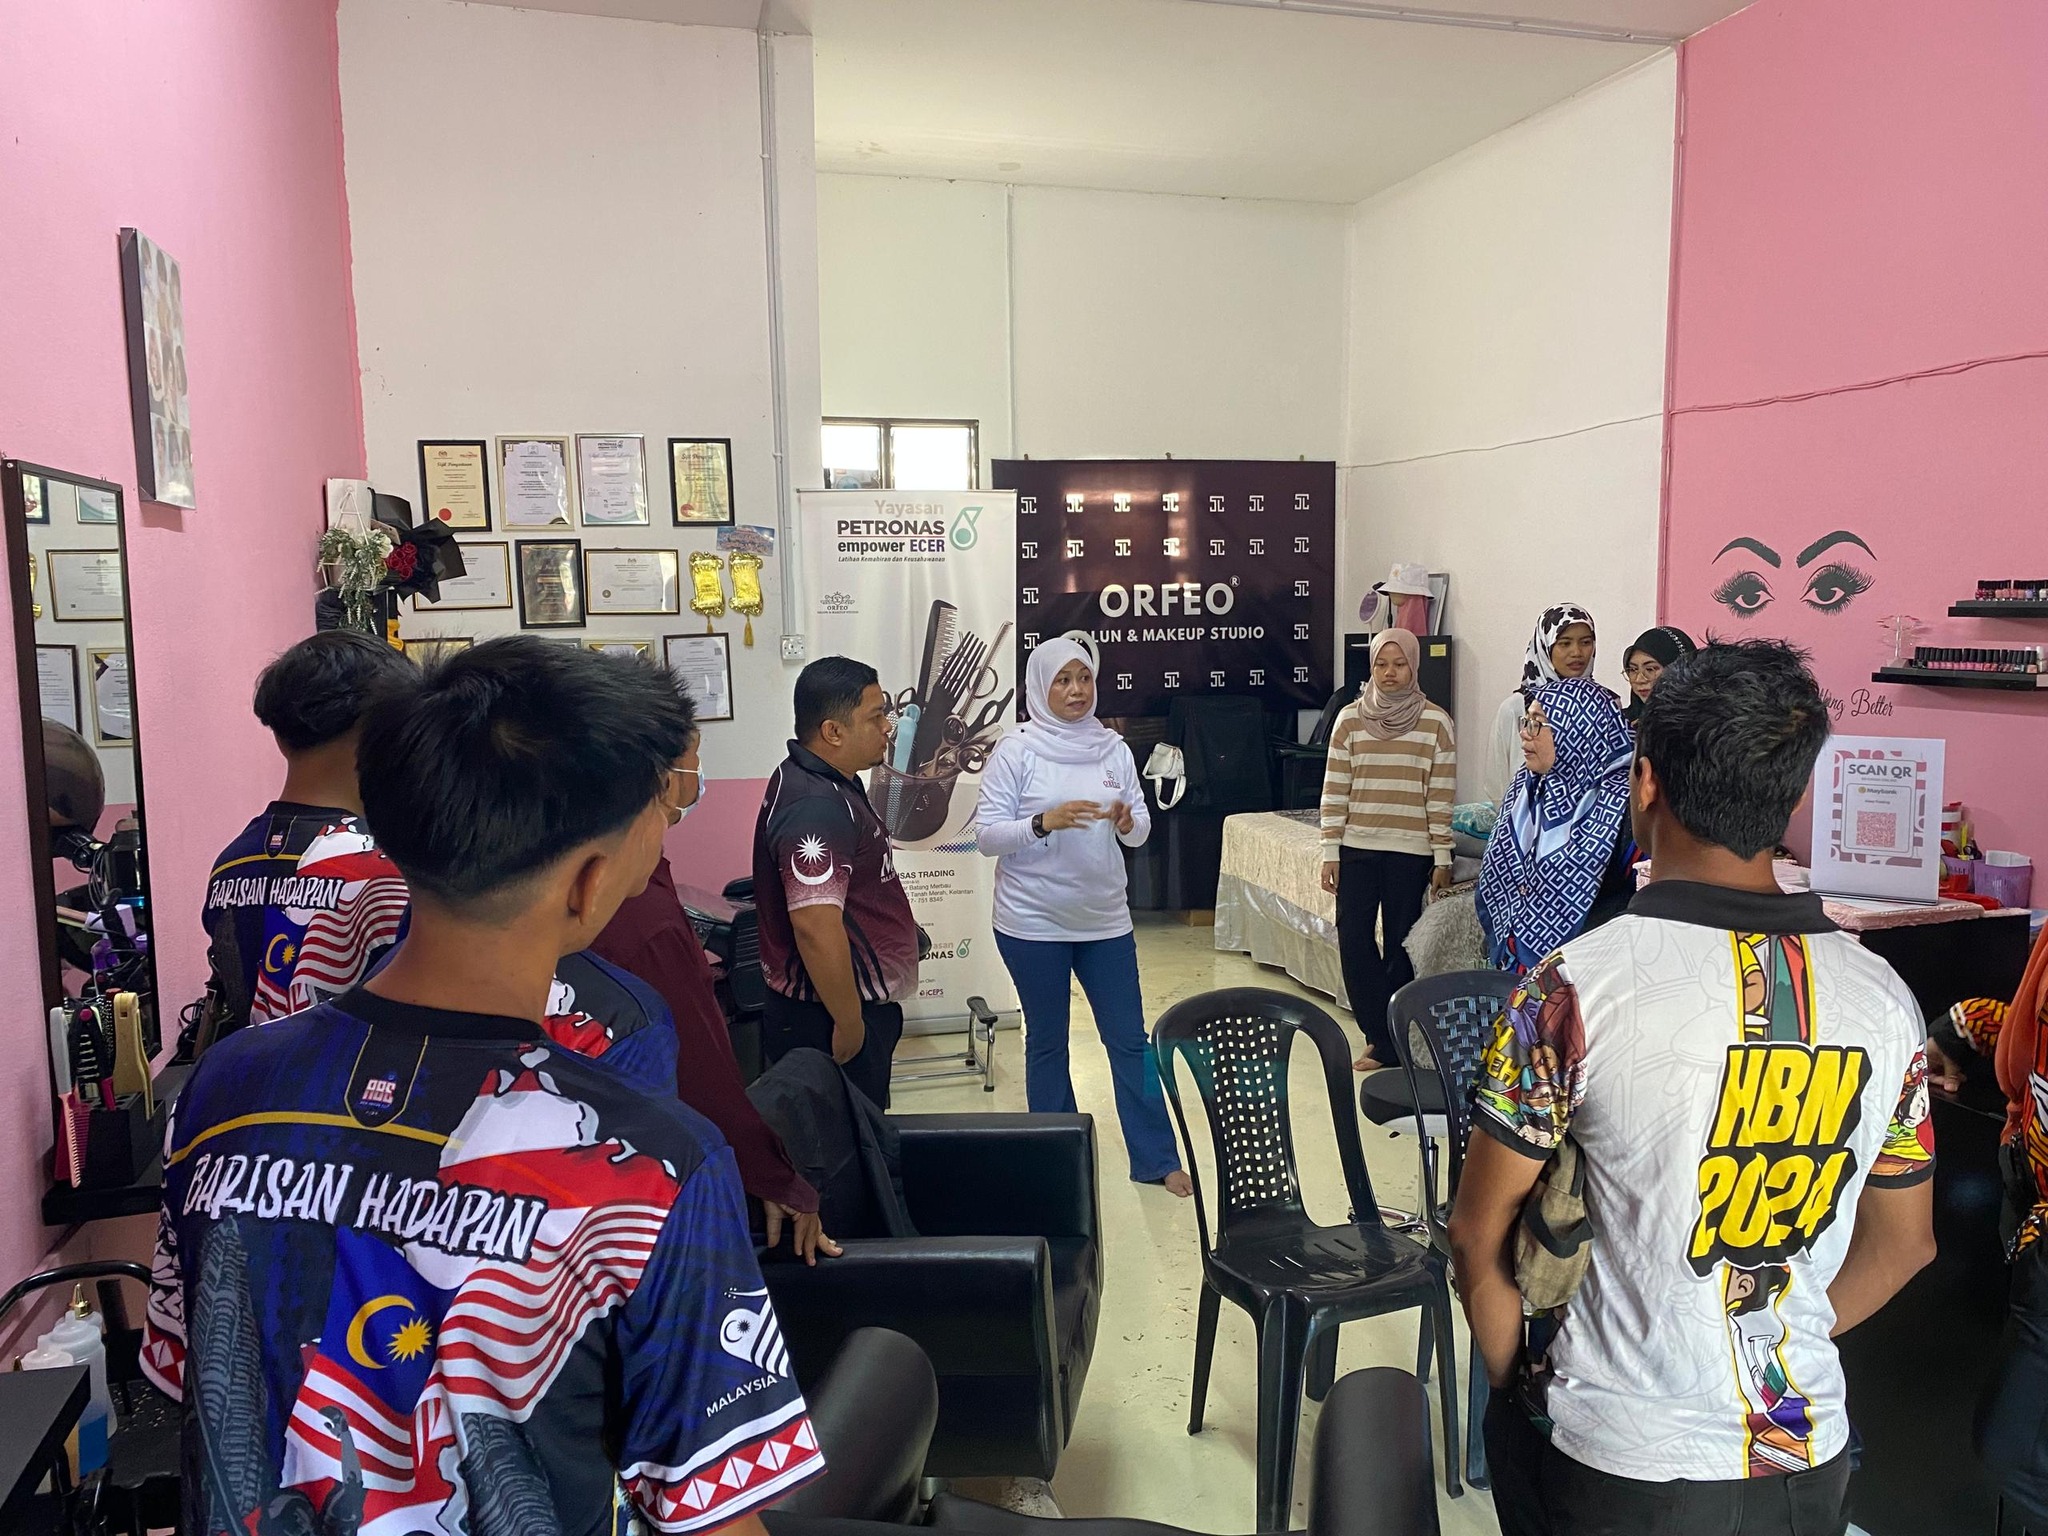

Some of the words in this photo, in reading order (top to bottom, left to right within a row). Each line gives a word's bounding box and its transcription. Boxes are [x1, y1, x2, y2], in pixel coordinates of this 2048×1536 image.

[874, 500, 944, 517] Yayasan
[837, 520, 945, 535] PETRONAS
[838, 540, 905, 555] empower
[909, 539, 945, 552] ECER
[1099, 582, 1234, 618] ORFEO
[1126, 629, 1139, 642] &
[1142, 627, 1205, 642] MAKEUP
[1210, 626, 1265, 640] STUDIO
[1851, 688, 1893, 717] Better
[1848, 764, 1887, 776] SCAN
[1891, 766, 1912, 779] QR
[898, 871, 916, 879] SAS
[918, 870, 955, 878] TRADING
[209, 876, 267, 910] BARISAN
[268, 876, 344, 910] HADAPAN
[1711, 1047, 1862, 1149] HBN
[183, 1153, 353, 1225] BARISAN
[353, 1170, 545, 1257] HADAPAN
[1691, 1151, 1847, 1259] 2024
[706, 1374, 777, 1418] MALAYSIA
